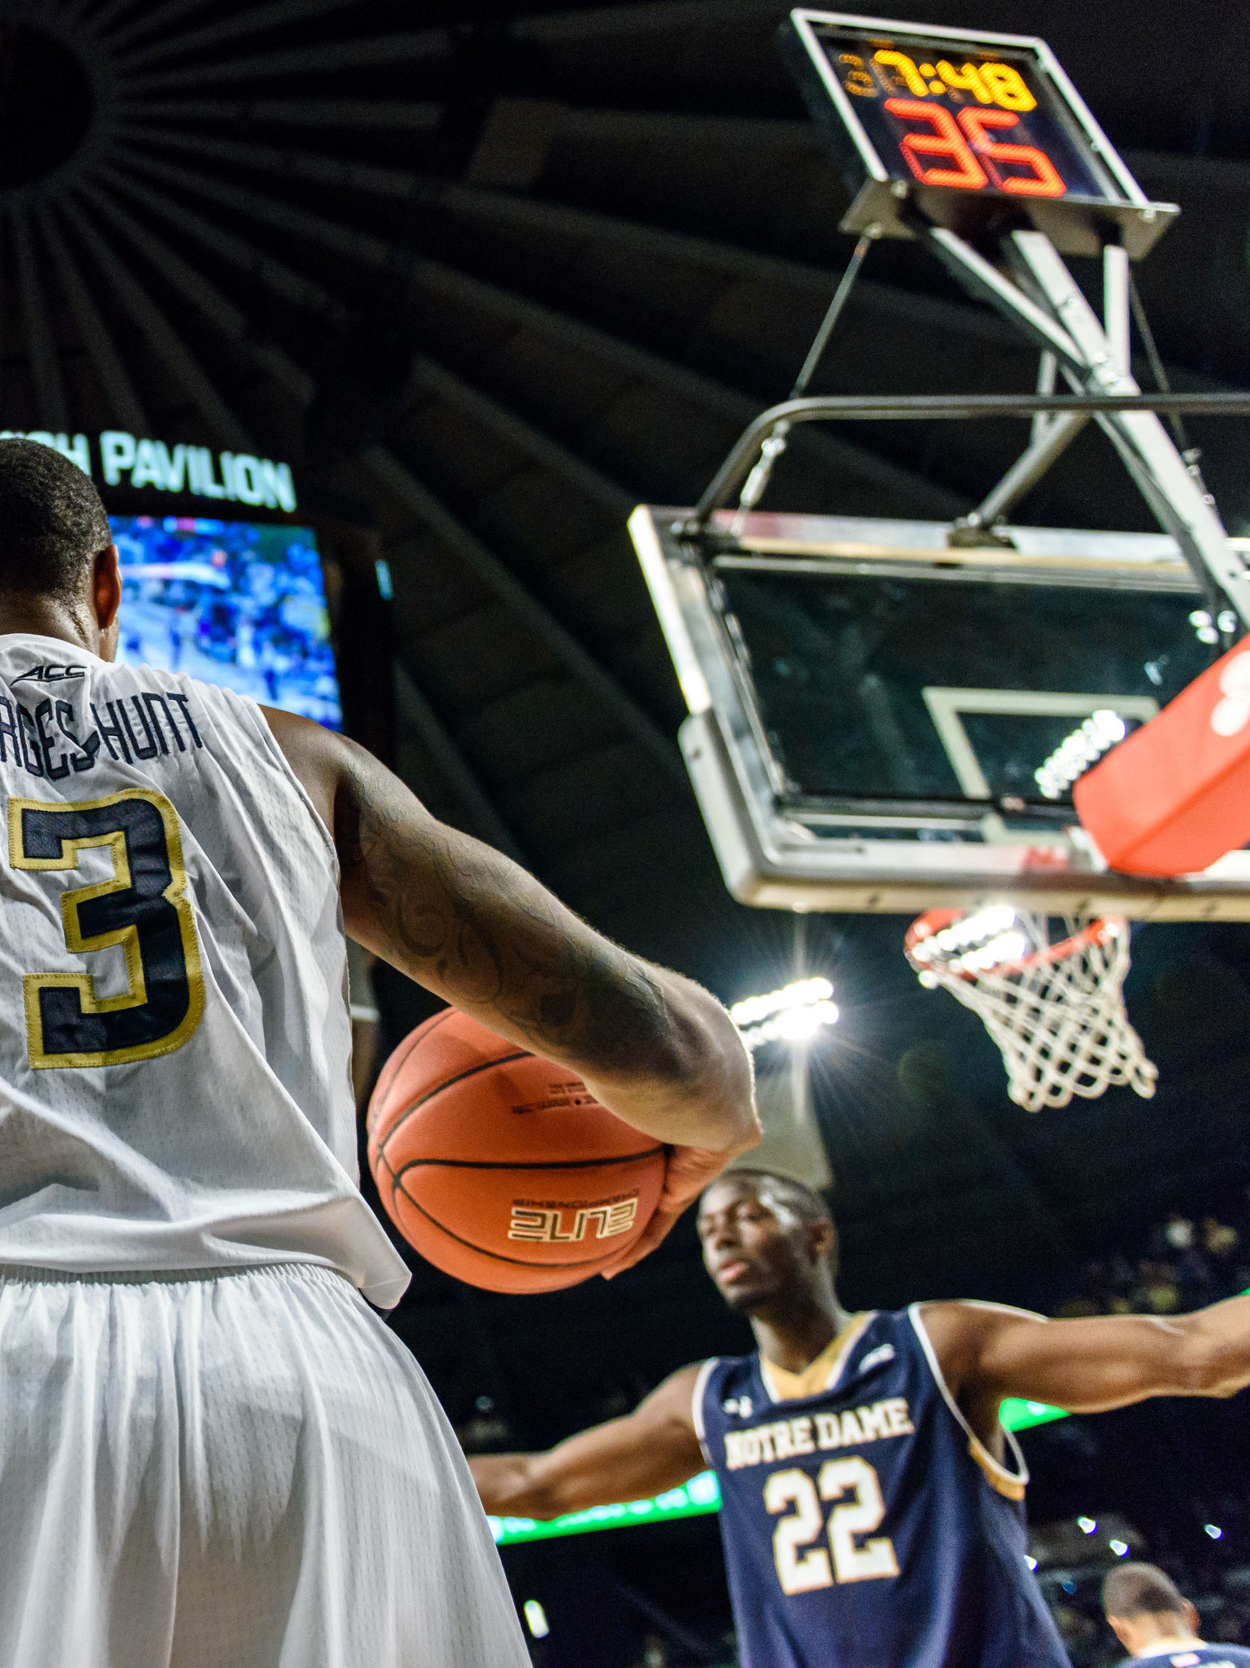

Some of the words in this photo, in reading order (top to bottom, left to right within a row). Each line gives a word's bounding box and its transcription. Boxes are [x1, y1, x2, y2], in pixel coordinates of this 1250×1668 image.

[873, 49, 1038, 112] 7:48
[883, 97, 1068, 198] 35
[99, 429, 298, 514] PAVILION
[15, 663, 88, 683] ACC
[7, 787, 206, 1069] 3
[507, 1197, 639, 1243] ELITE
[724, 1416, 816, 1471] NOTRE
[813, 1397, 916, 1451] DAME
[762, 1455, 901, 1596] 22
